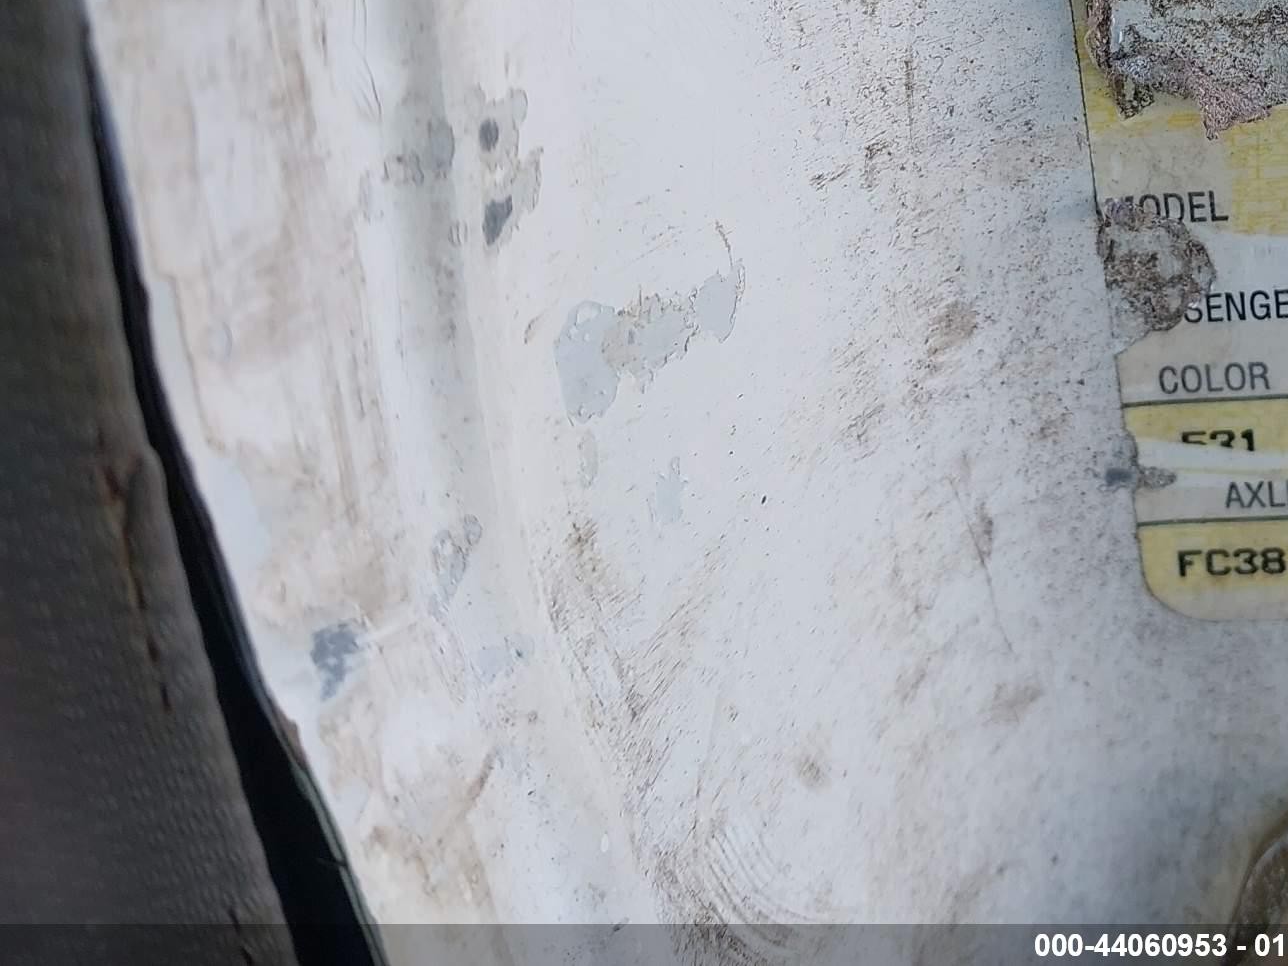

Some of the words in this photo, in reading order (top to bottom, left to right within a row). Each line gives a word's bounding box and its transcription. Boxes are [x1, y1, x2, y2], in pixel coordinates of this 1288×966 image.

[1124, 190, 1230, 224] ODEL
[1158, 361, 1270, 394] COLOR
[1178, 547, 1286, 577] FC38
